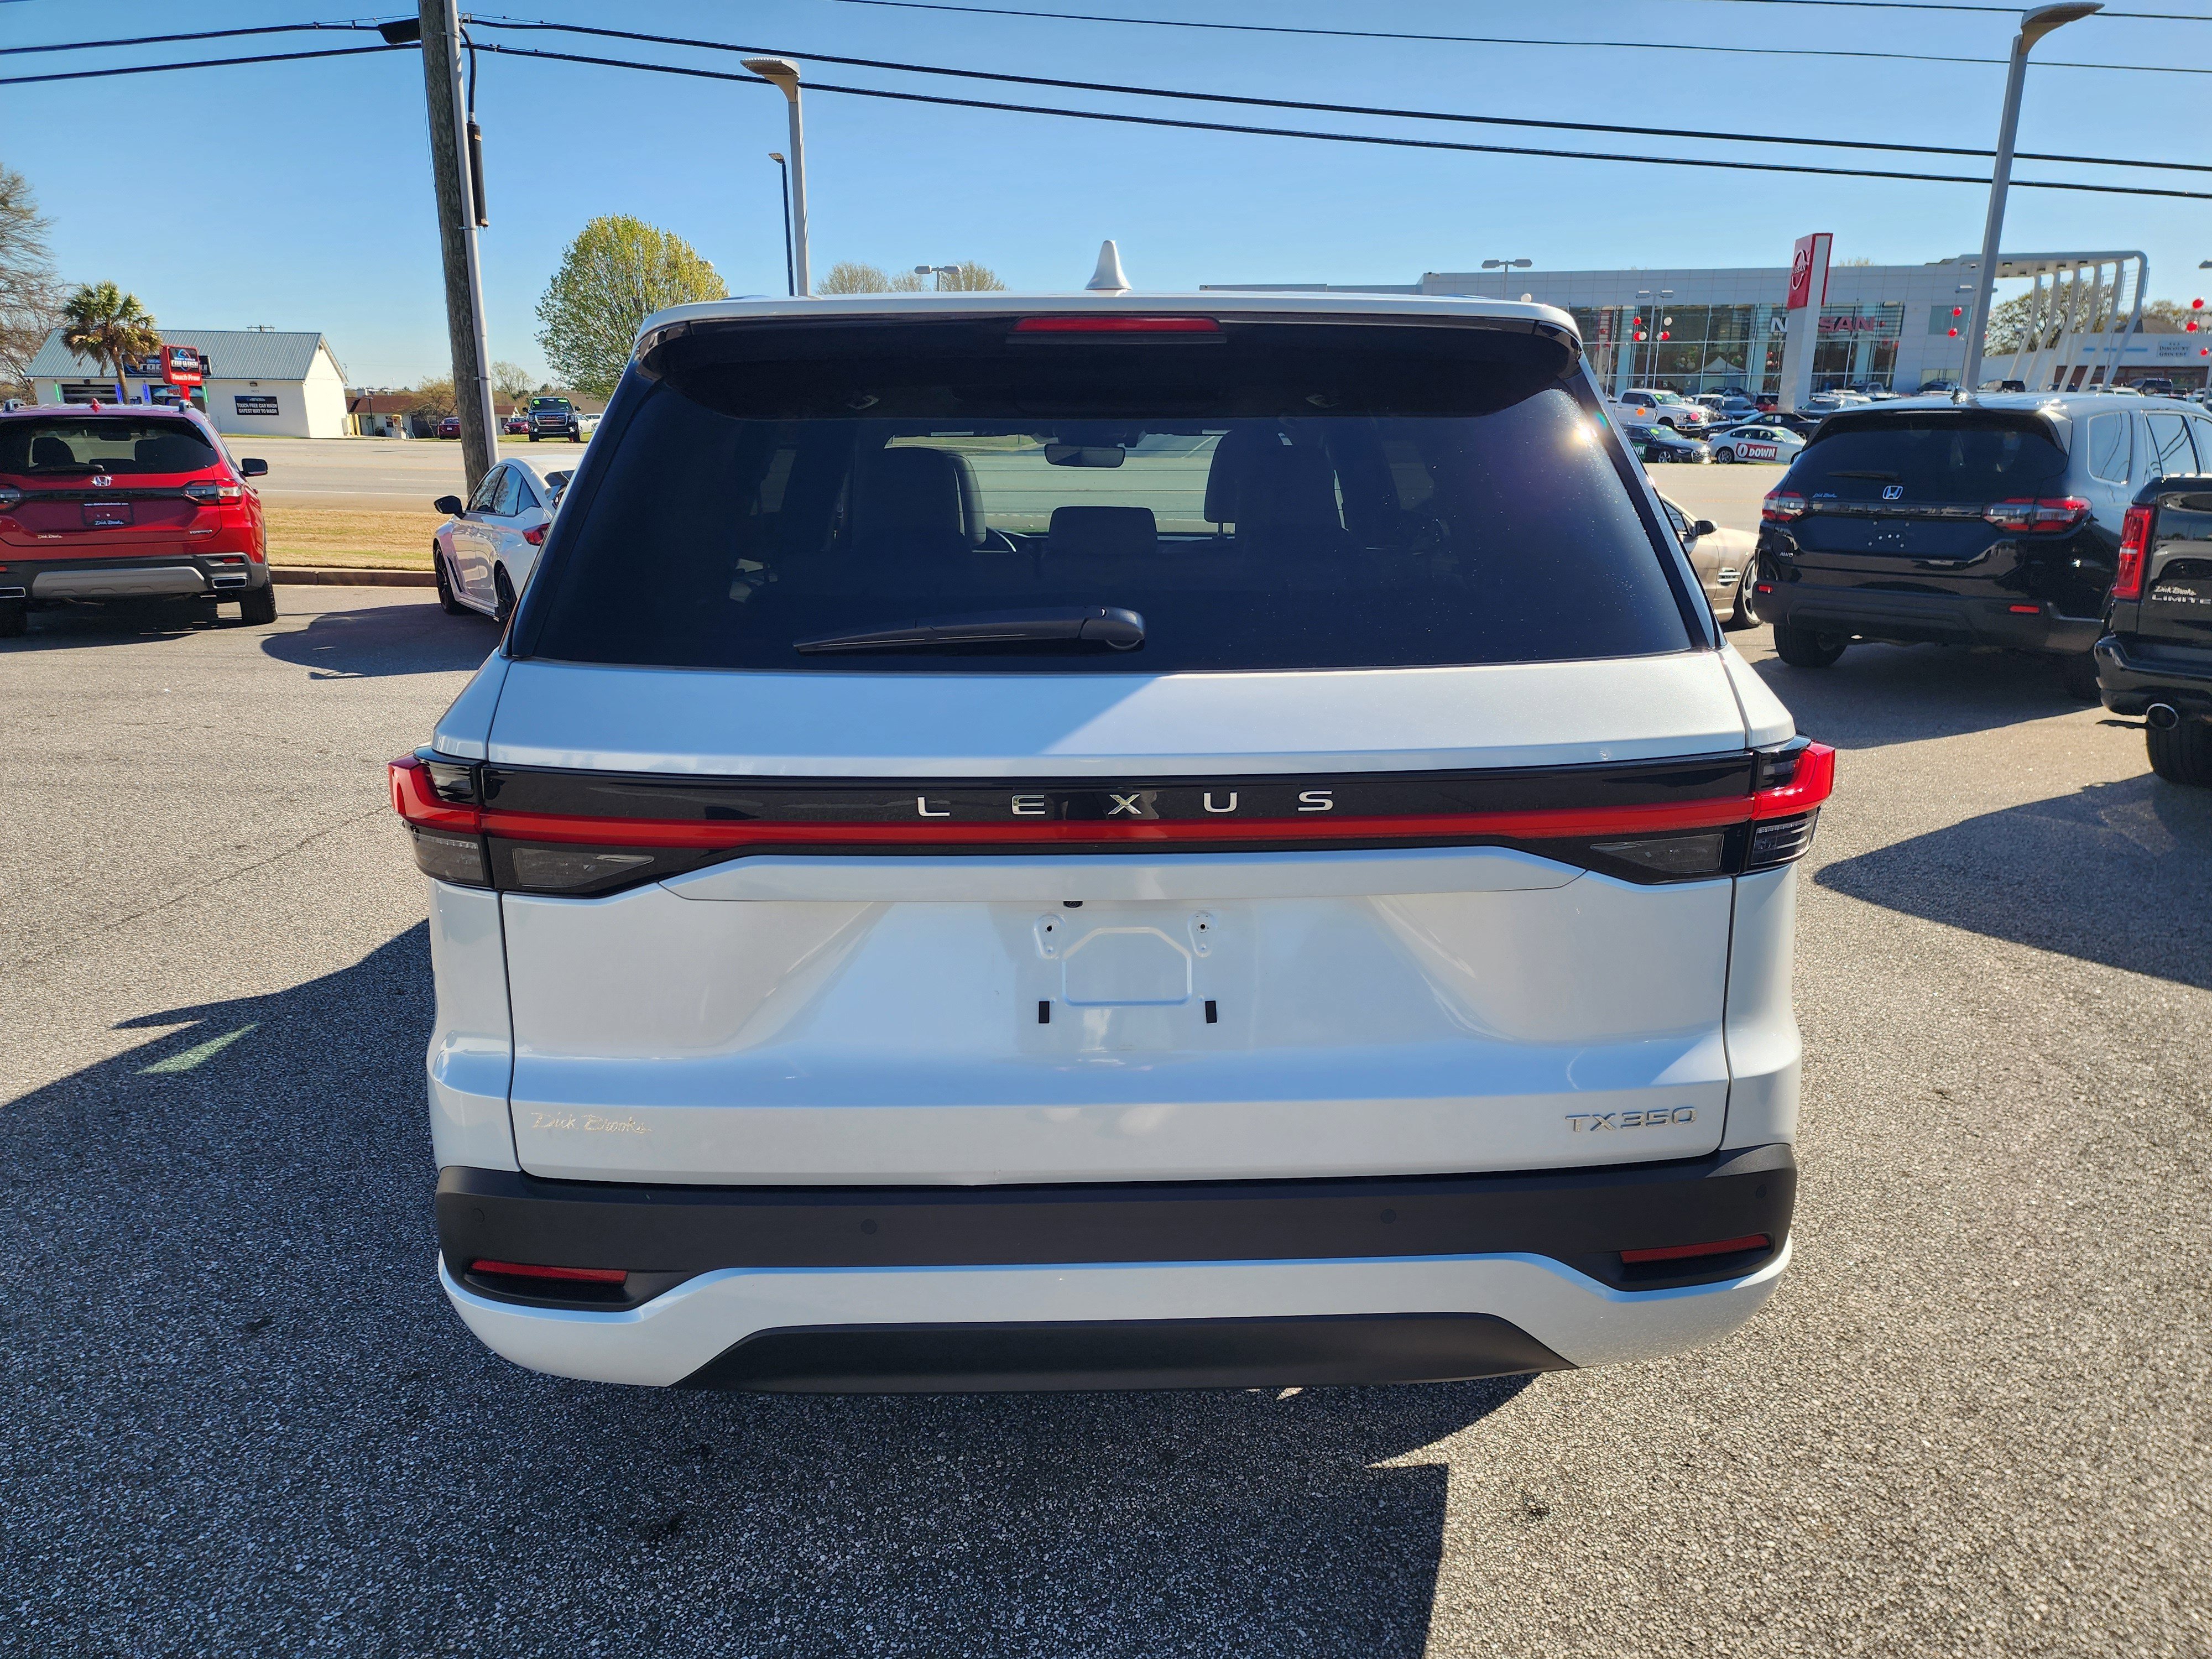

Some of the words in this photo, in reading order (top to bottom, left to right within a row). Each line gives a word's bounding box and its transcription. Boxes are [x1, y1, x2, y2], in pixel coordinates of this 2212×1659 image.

[1771, 316, 1875, 333] NSAN
[1749, 447, 1776, 458] DOWN
[2152, 594, 2211, 605] LIMITE
[917, 791, 1333, 817] LEXUS
[531, 1112, 580, 1130] Dick
[581, 1114, 653, 1134] Brooks
[1565, 1107, 1698, 1133] TX350
